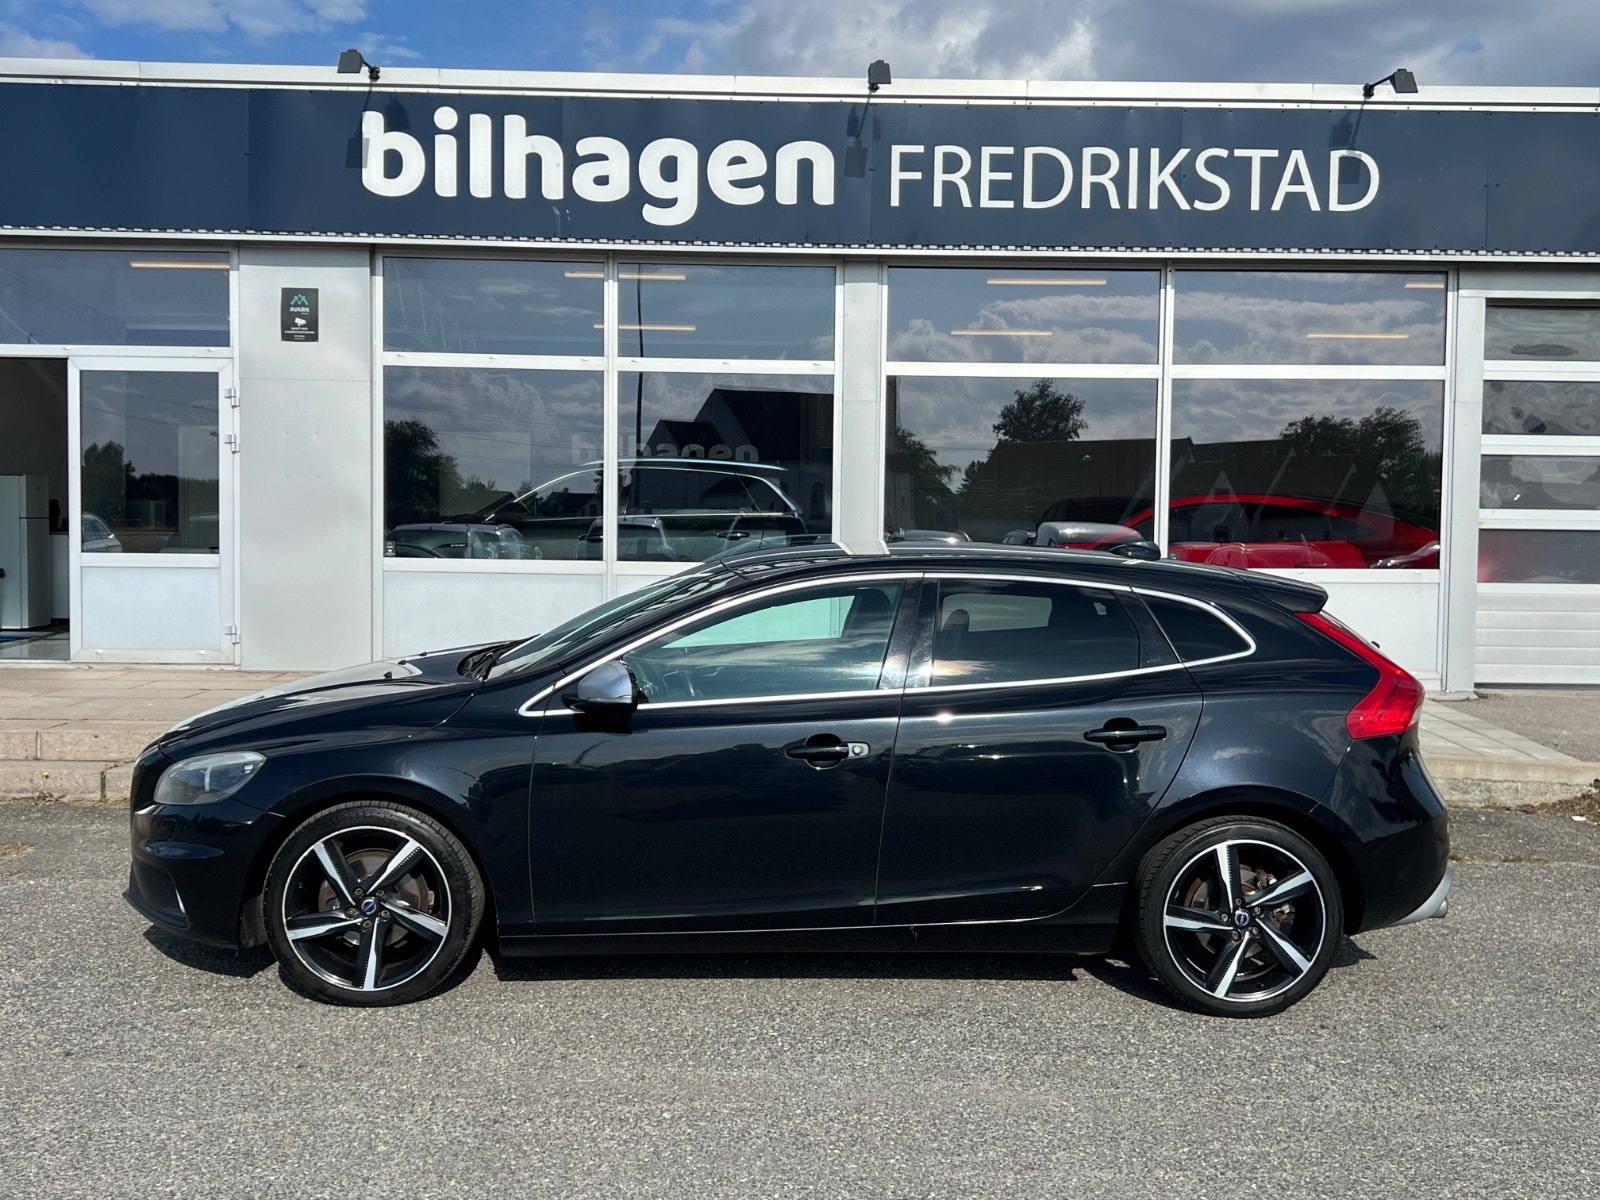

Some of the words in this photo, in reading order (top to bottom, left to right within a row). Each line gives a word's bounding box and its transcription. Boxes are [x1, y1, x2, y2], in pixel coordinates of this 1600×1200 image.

[361, 106, 836, 226] bilhagen
[890, 144, 1380, 213] FREDRIKSTAD
[571, 432, 760, 465] bhaen
